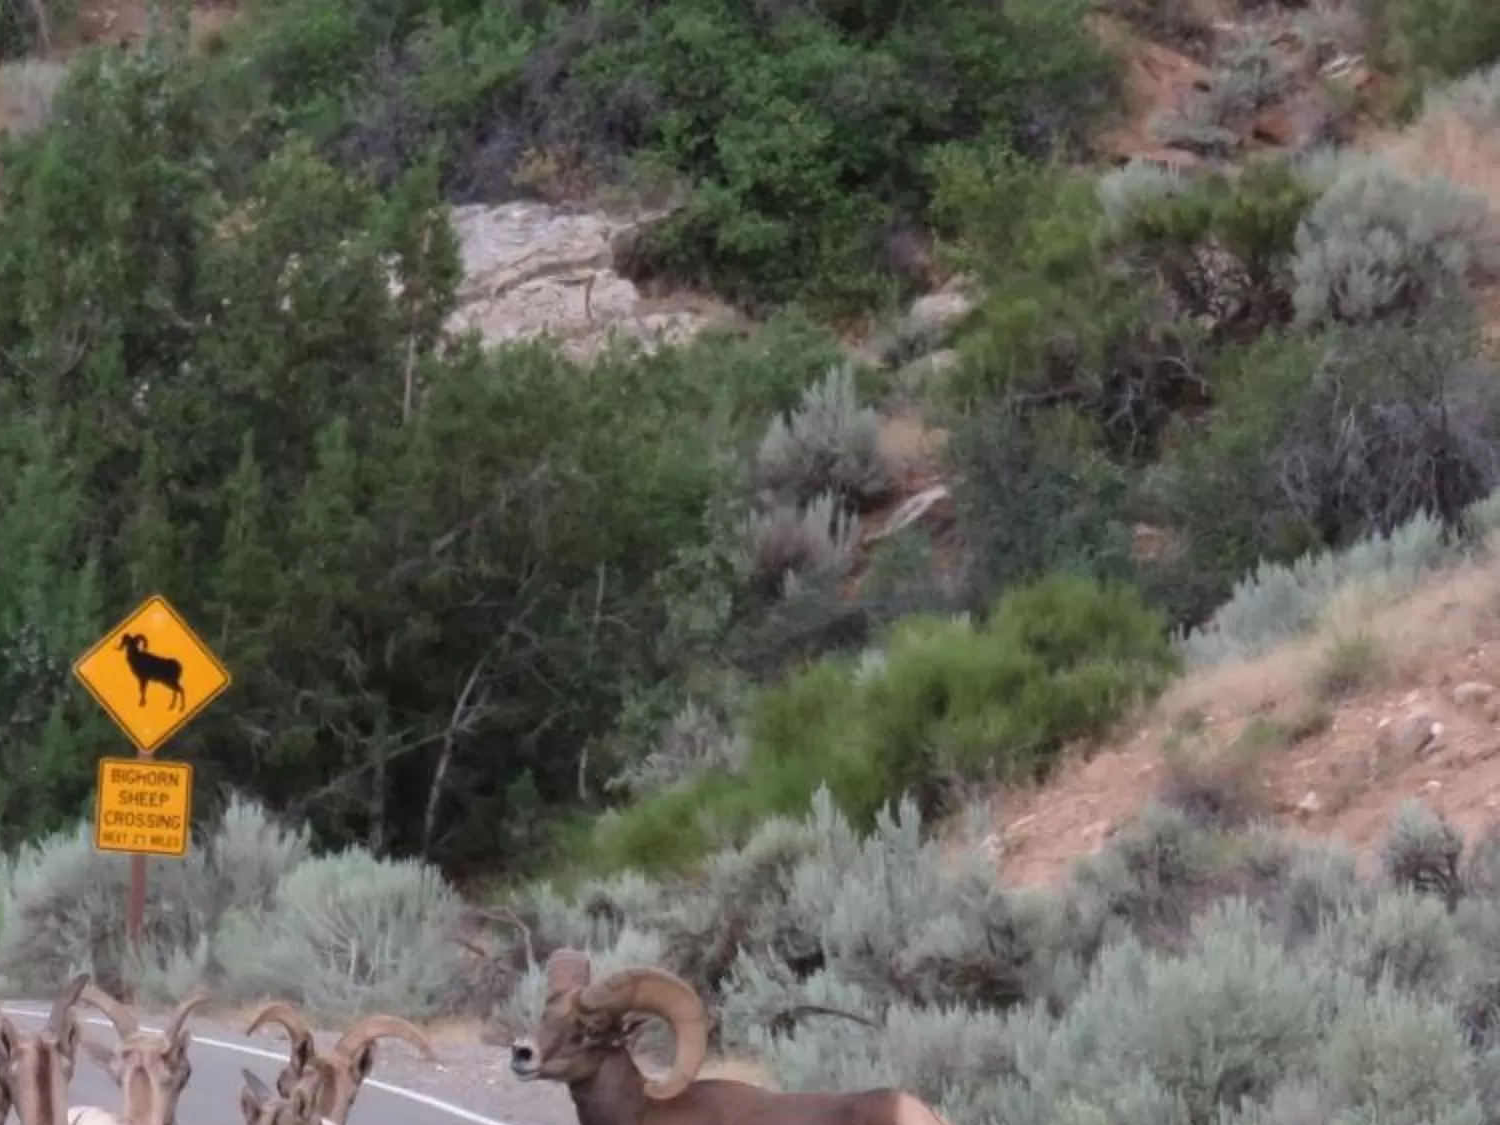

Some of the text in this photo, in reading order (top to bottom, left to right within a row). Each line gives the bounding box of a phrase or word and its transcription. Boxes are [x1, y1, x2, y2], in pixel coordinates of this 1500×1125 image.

[111, 767, 180, 787] BIGHORN
[117, 789, 170, 808] SHEEP
[103, 811, 181, 830] CROSSING
